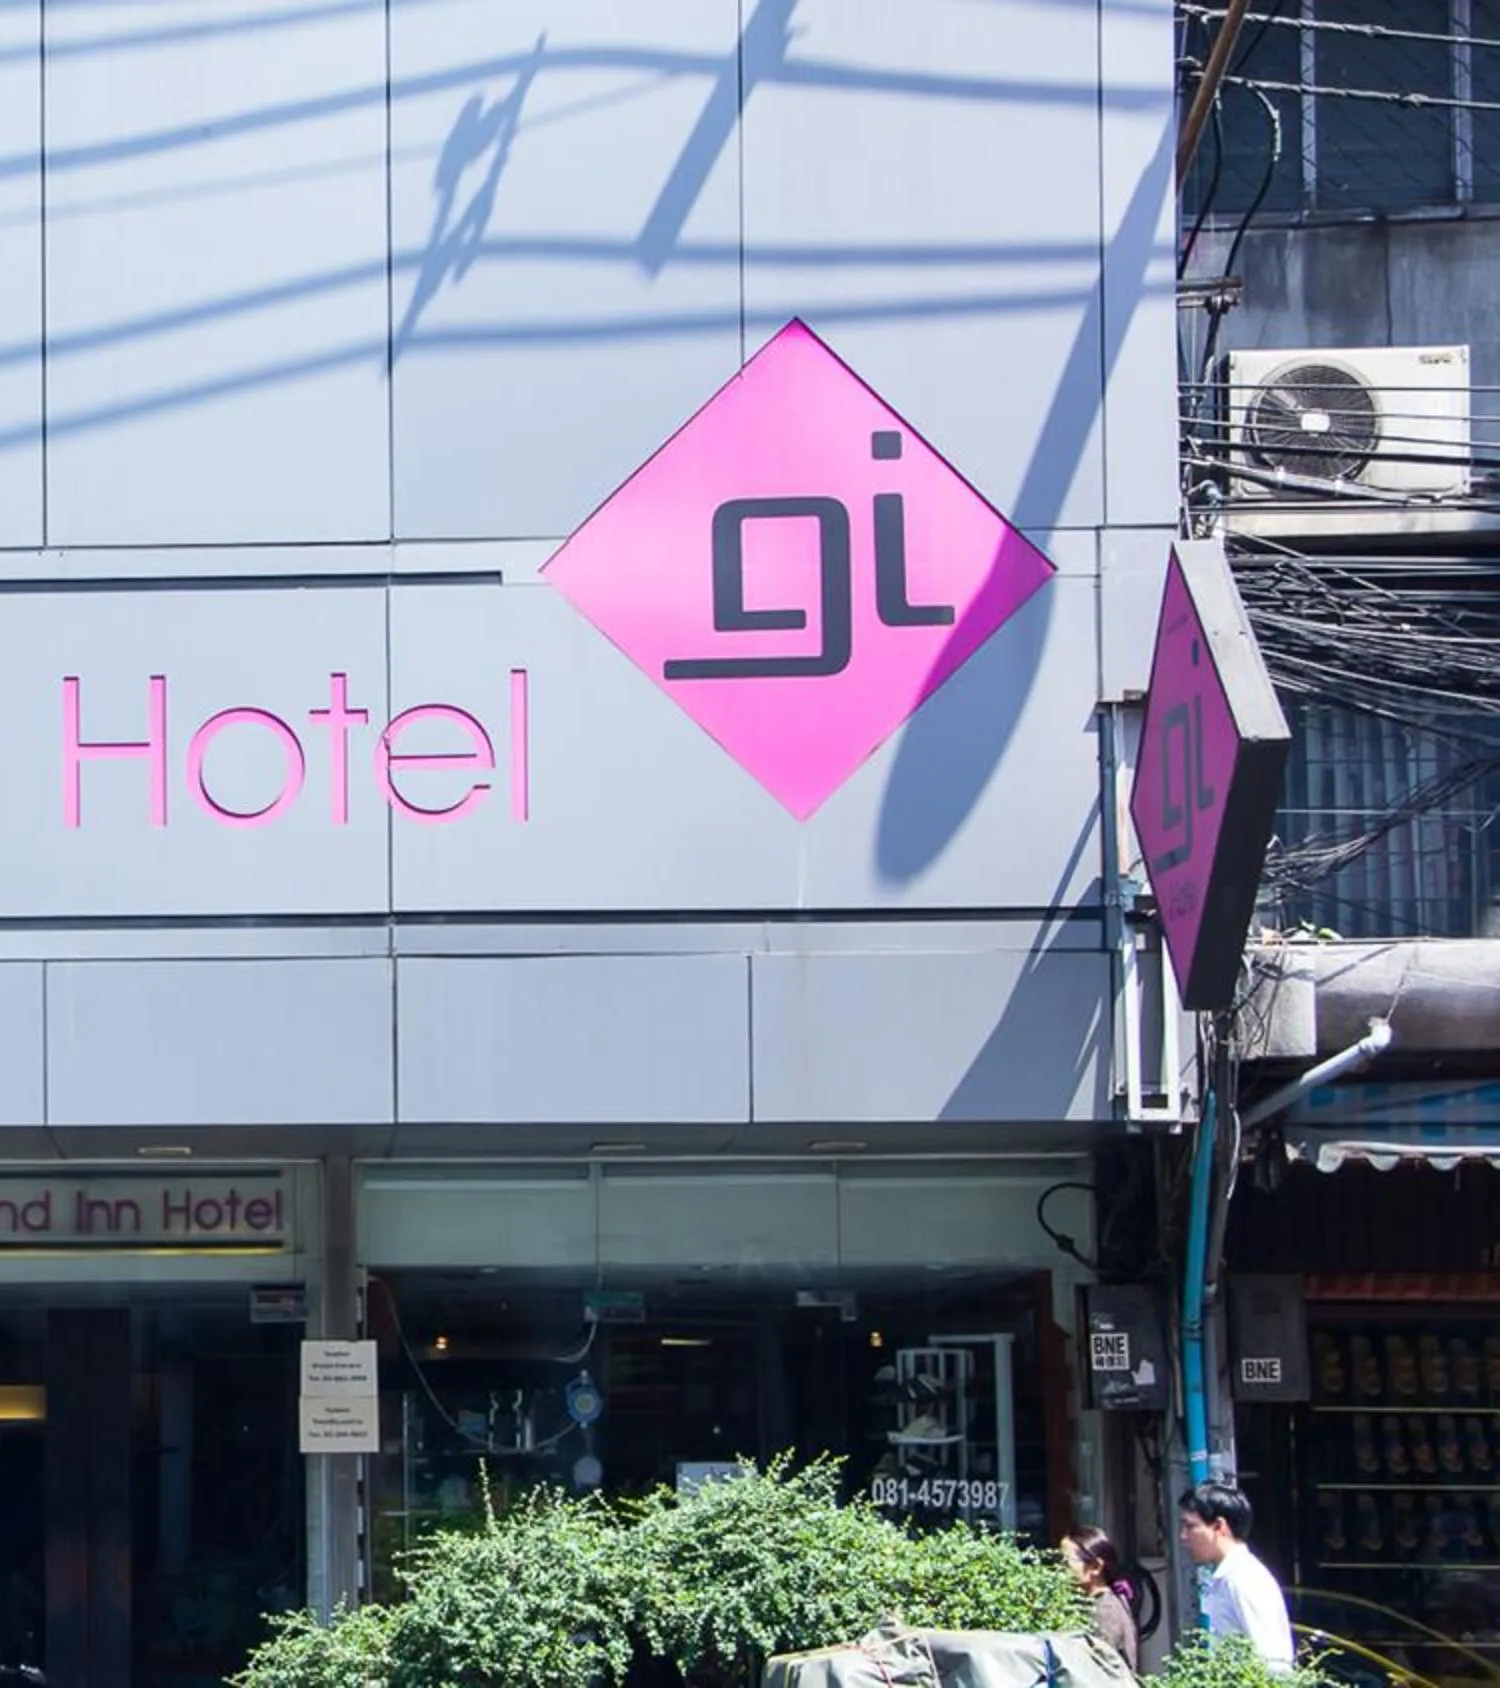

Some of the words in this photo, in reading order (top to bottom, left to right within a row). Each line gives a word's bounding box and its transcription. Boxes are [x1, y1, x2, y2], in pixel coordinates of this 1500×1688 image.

[663, 430, 955, 681] gi
[62, 668, 529, 831] Hotel
[75, 1189, 142, 1233] Inn
[162, 1188, 284, 1233] Hotel
[1094, 1335, 1125, 1354] BNE
[1245, 1361, 1280, 1379] BNE
[871, 1478, 1011, 1509] 081-4573987
